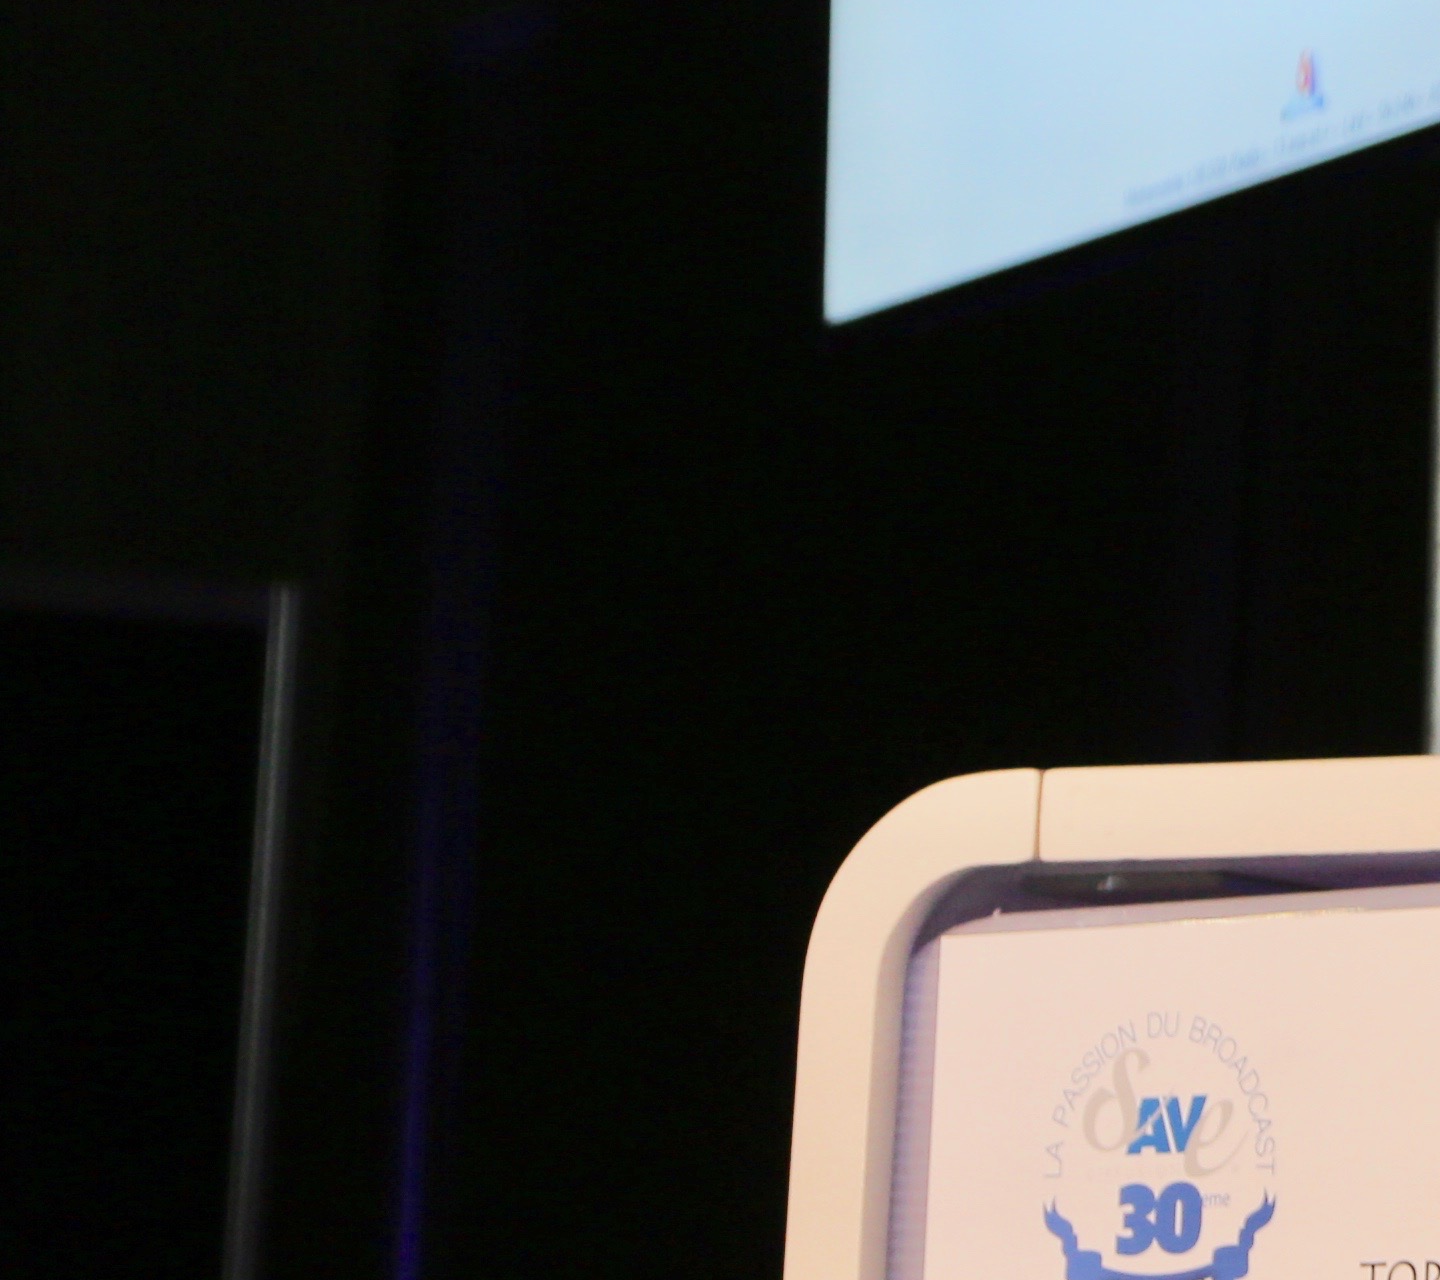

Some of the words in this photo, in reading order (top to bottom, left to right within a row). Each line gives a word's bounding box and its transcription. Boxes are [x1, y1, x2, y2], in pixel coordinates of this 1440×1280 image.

[1147, 1011, 1181, 1038] DU
[1053, 1020, 1138, 1128] PASSION
[1189, 1016, 1276, 1176] BROADCAST
[1043, 1140, 1064, 1178] LA
[1116, 1182, 1203, 1256] 30
